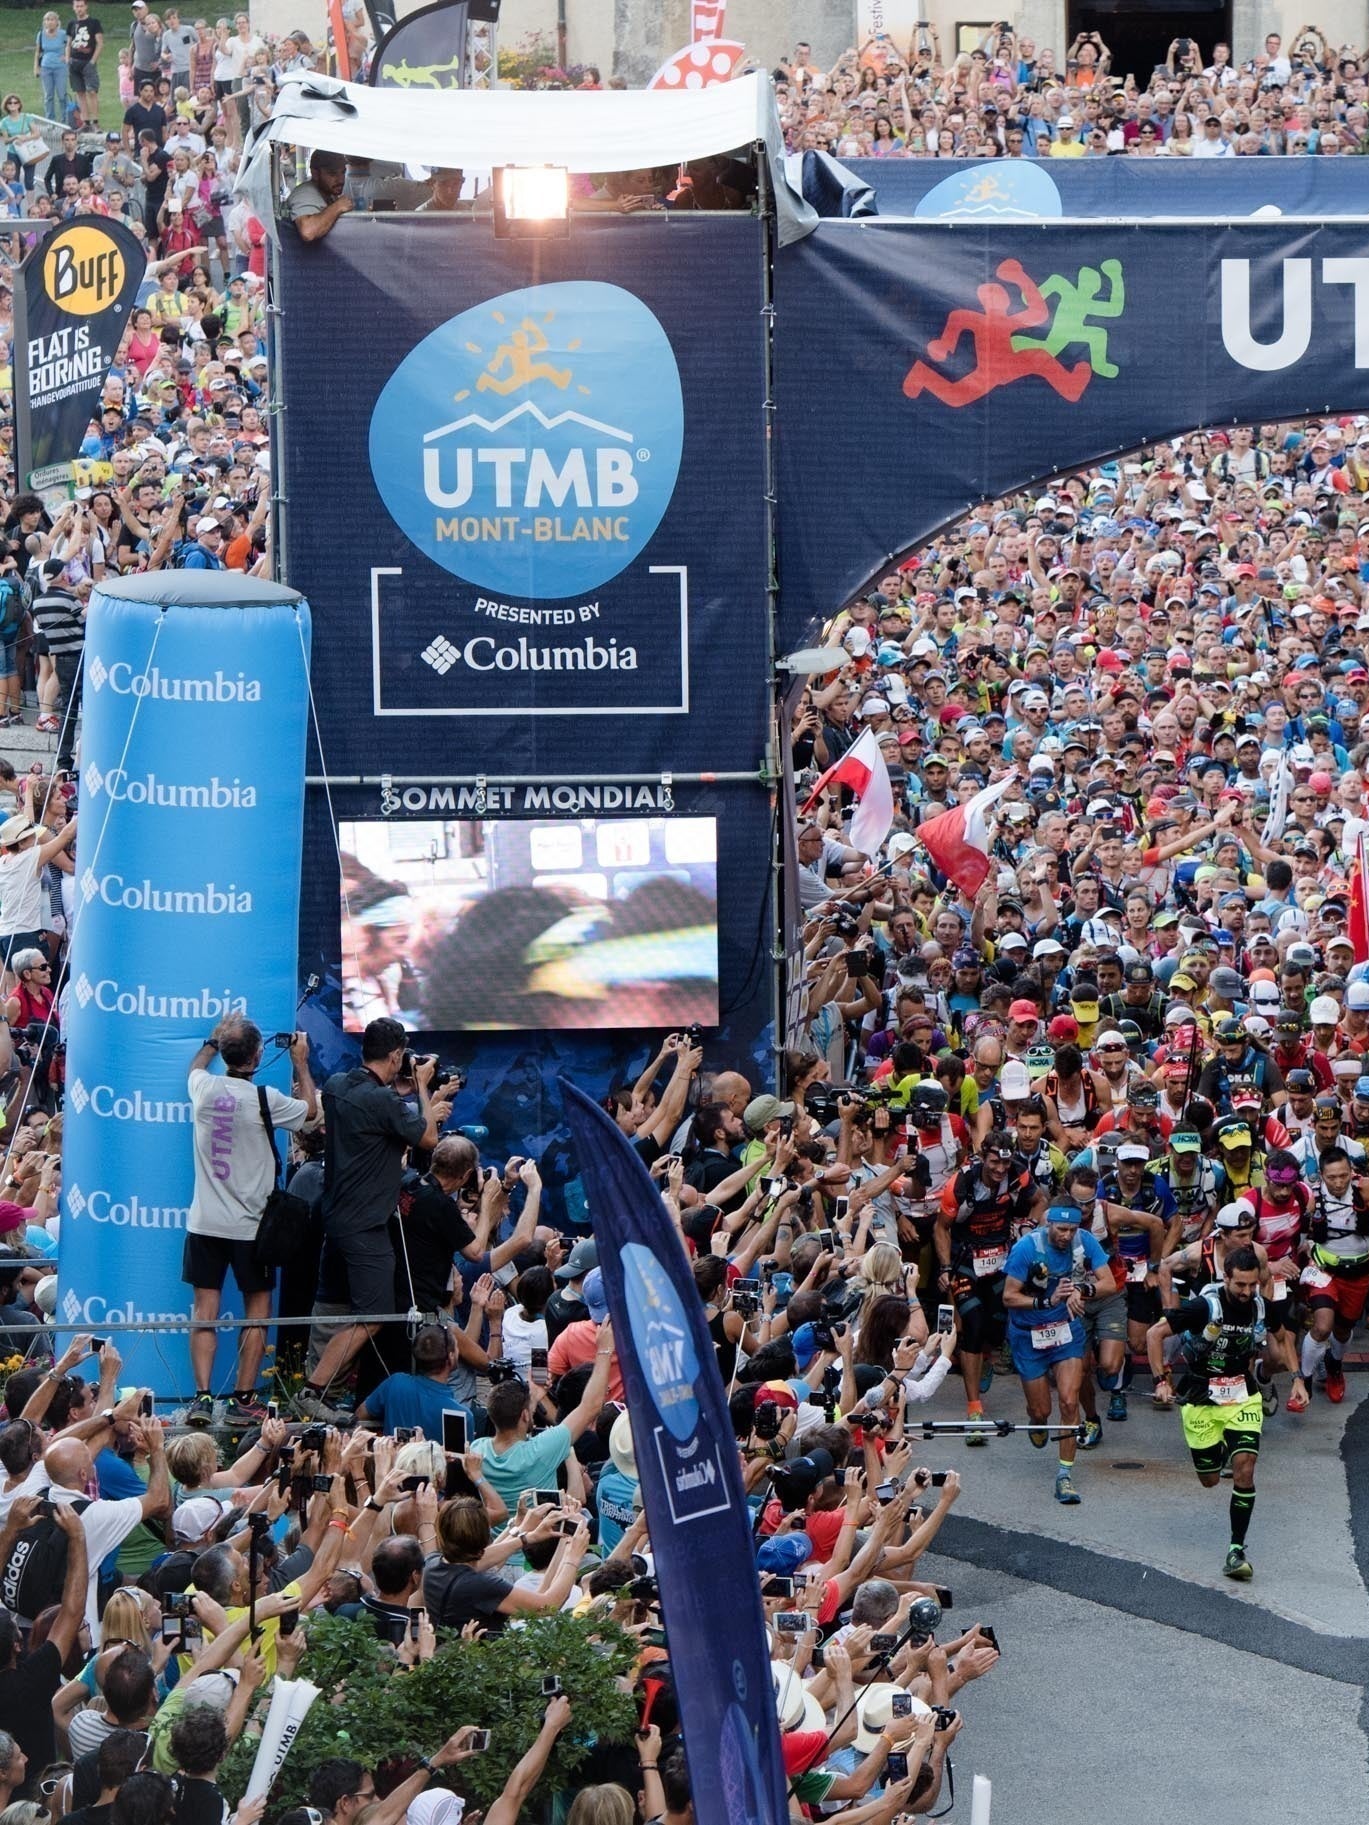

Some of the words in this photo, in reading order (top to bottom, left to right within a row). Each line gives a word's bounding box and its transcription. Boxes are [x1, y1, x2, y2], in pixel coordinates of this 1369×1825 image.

[28, 327, 73, 368] FLAT
[74, 325, 91, 348] IS
[30, 375, 101, 410] HANGEYOURATTITUDE
[435, 516, 631, 542] MONT-BLANC
[474, 598, 575, 625] PRESENTED
[578, 602, 601, 622] BY
[463, 636, 639, 672] Columbia
[109, 662, 262, 702] Columbia
[104, 768, 257, 808] Columbia
[388, 786, 516, 810] SOMMET
[100, 874, 252, 914] Columbia
[95, 980, 248, 1018] Columbia
[90, 1085, 194, 1123] Colum
[210, 1094, 236, 1181] UTMB
[87, 1190, 191, 1229] Colum
[981, 1258, 997, 1266] 140
[1040, 1328, 1056, 1338] 139
[1220, 1387, 1230, 1395] 91
[3, 1540, 30, 1608] adidas
